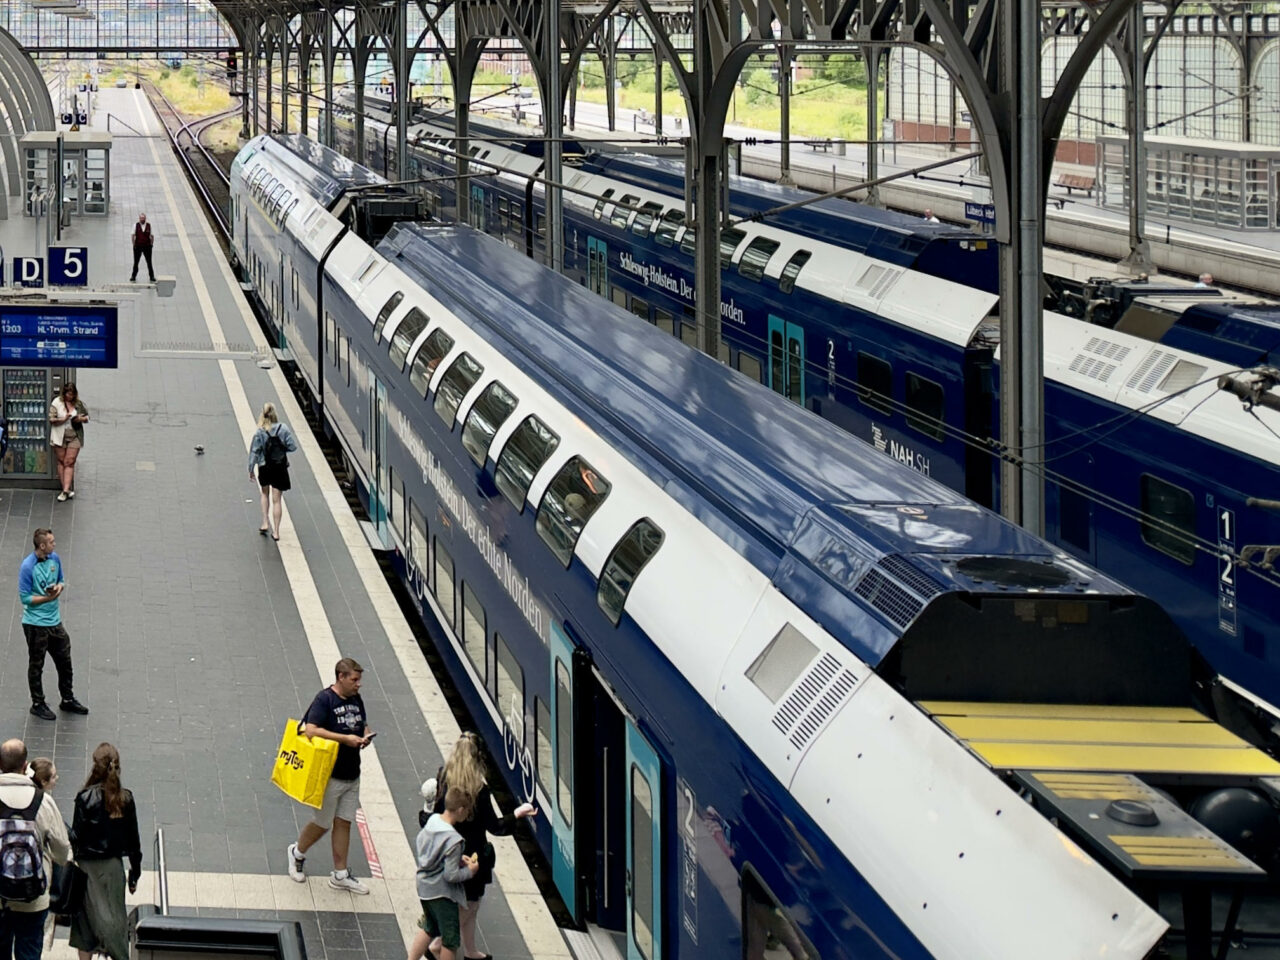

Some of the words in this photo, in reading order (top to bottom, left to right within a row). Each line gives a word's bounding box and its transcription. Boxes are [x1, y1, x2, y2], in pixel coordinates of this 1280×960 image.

[22, 258, 40, 280] D
[63, 248, 83, 277] 5
[619, 251, 679, 294] Schleswig-Holstein.
[680, 278, 694, 300] Der
[720, 298, 747, 325] orden.
[73, 326, 99, 335] Strand
[828, 340, 835, 359] 2
[890, 439, 930, 478] NAH.SH
[462, 495, 476, 540] Der
[1221, 510, 1230, 540] 1
[1221, 553, 1233, 585] 2
[280, 750, 304, 770] myToys
